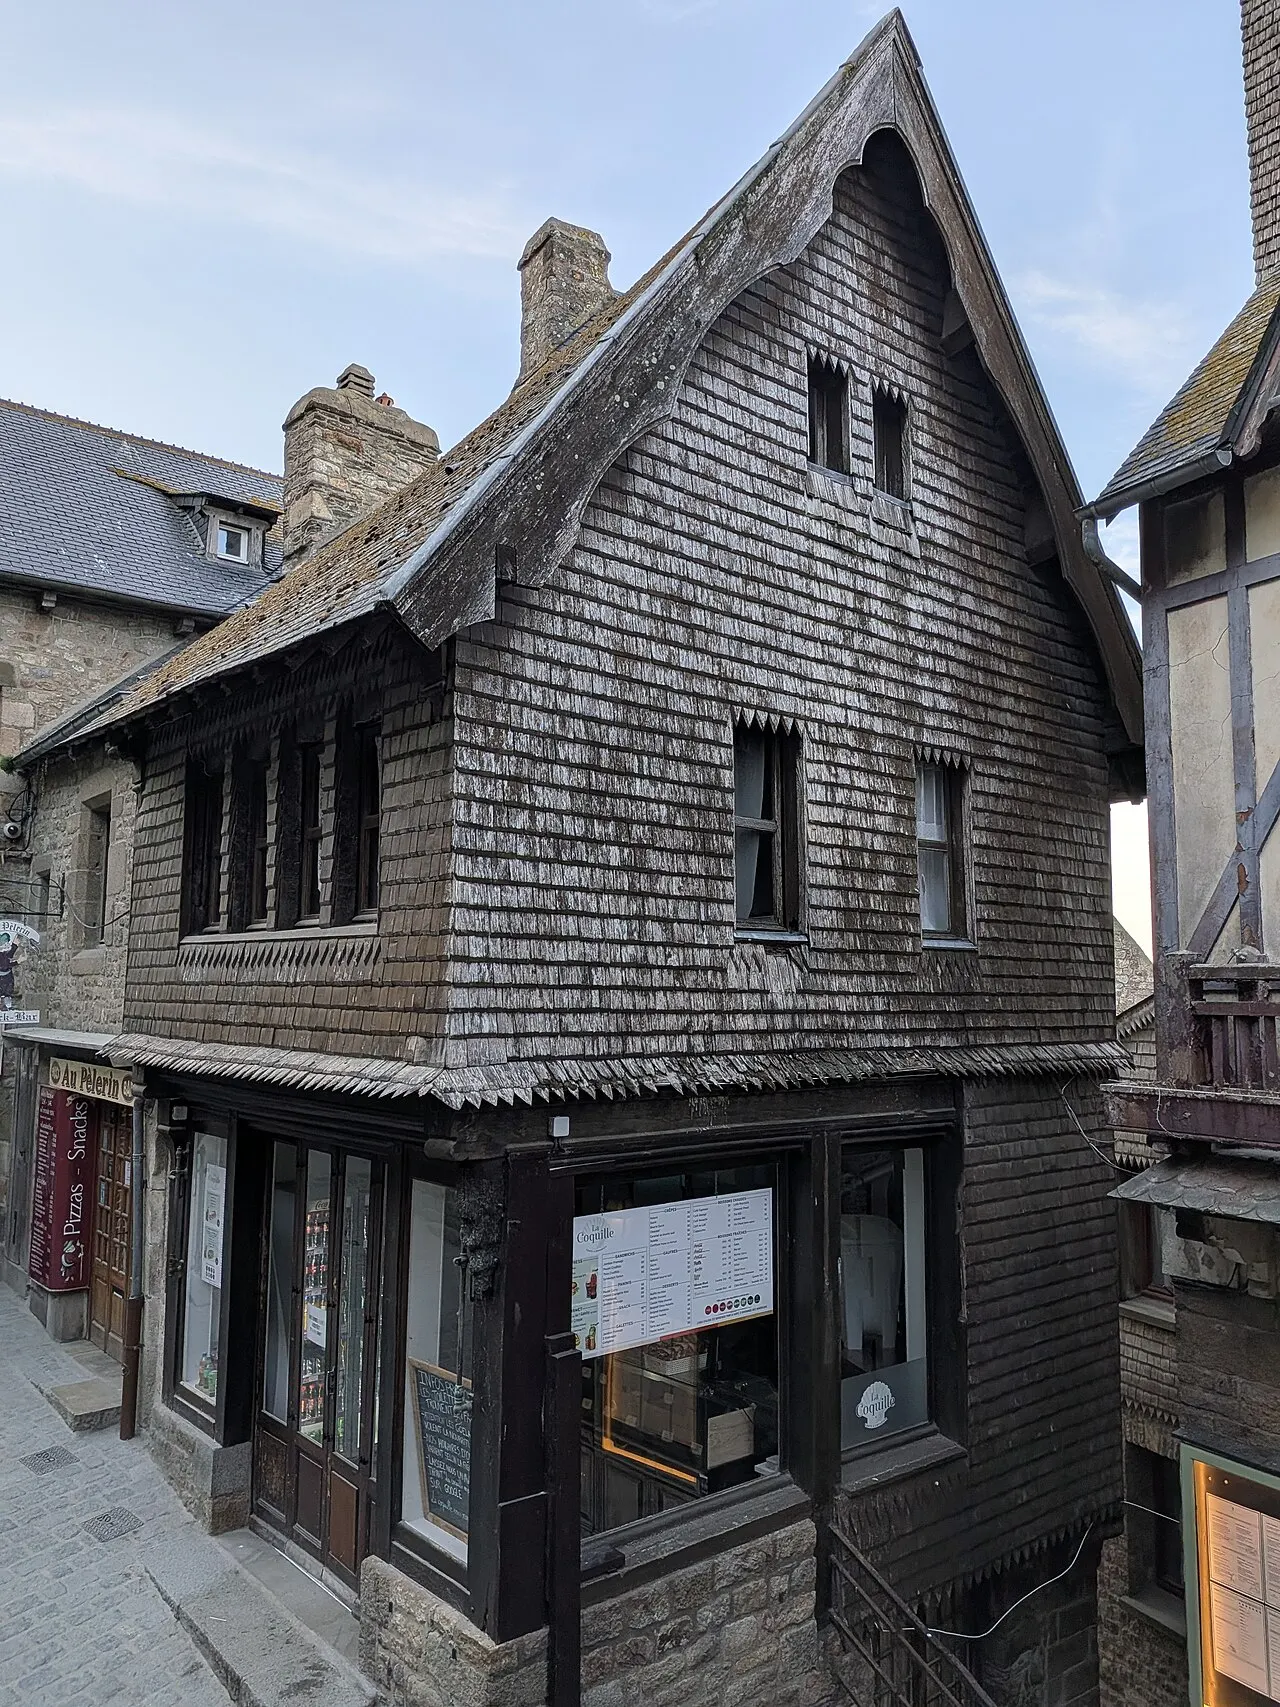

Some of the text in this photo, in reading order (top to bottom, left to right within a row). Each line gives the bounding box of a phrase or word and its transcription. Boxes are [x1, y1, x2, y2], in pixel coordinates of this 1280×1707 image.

[61, 1063, 77, 1089] Au
[80, 1066, 119, 1100] Pèlerin
[67, 1101, 88, 1160] Snacks
[63, 1183, 84, 1236] Pizzas
[576, 1227, 614, 1244] Coquille
[855, 1394, 896, 1417] Coquille
